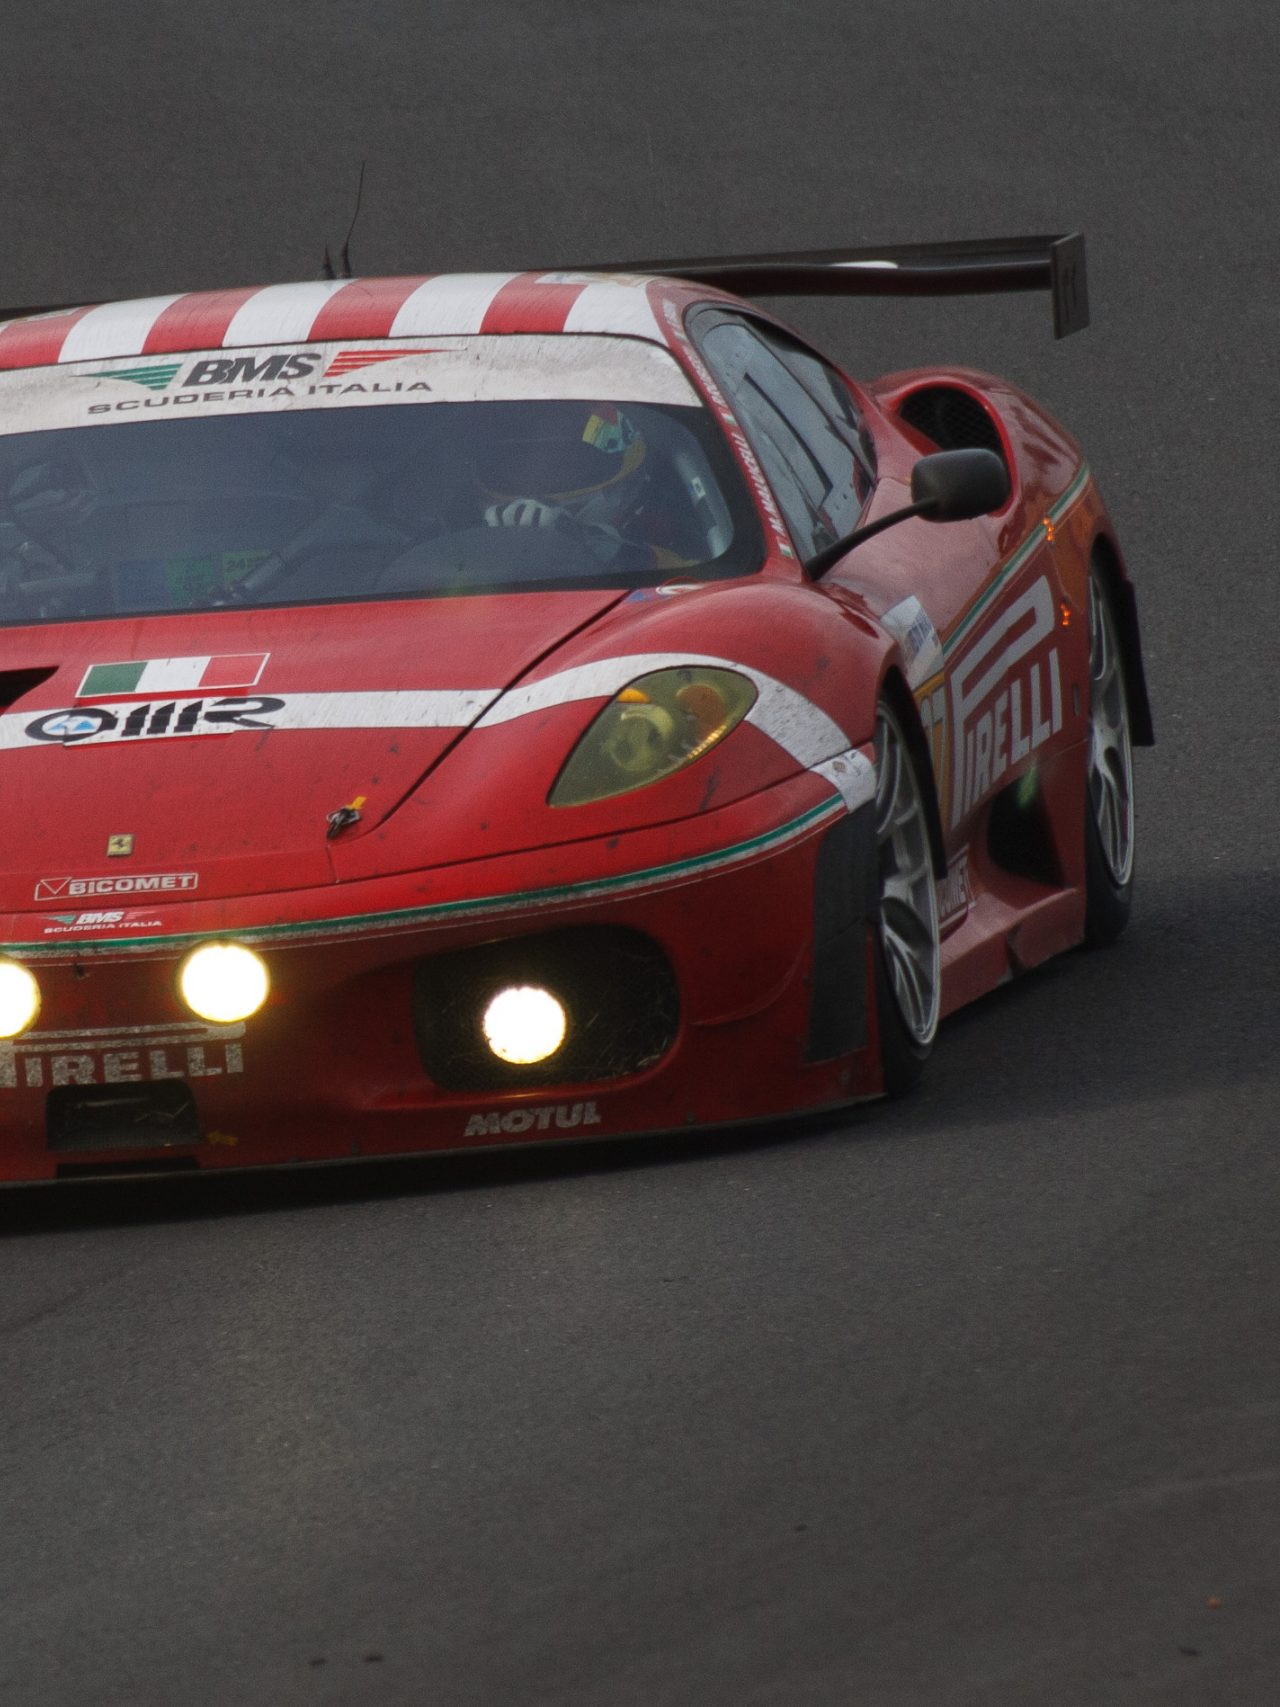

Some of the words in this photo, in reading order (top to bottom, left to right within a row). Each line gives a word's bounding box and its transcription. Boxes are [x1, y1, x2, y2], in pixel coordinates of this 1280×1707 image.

[182, 353, 323, 388] BMS
[87, 386, 295, 414] SCUDERIA
[308, 381, 433, 396] ITALIA
[950, 575, 1062, 831] PIRELLI
[69, 874, 194, 895] BICOMET
[44, 923, 116, 934] SCUDERIA
[119, 920, 162, 929] ITALIA
[76, 911, 125, 925] BMS
[464, 1102, 602, 1136] MOTUL
